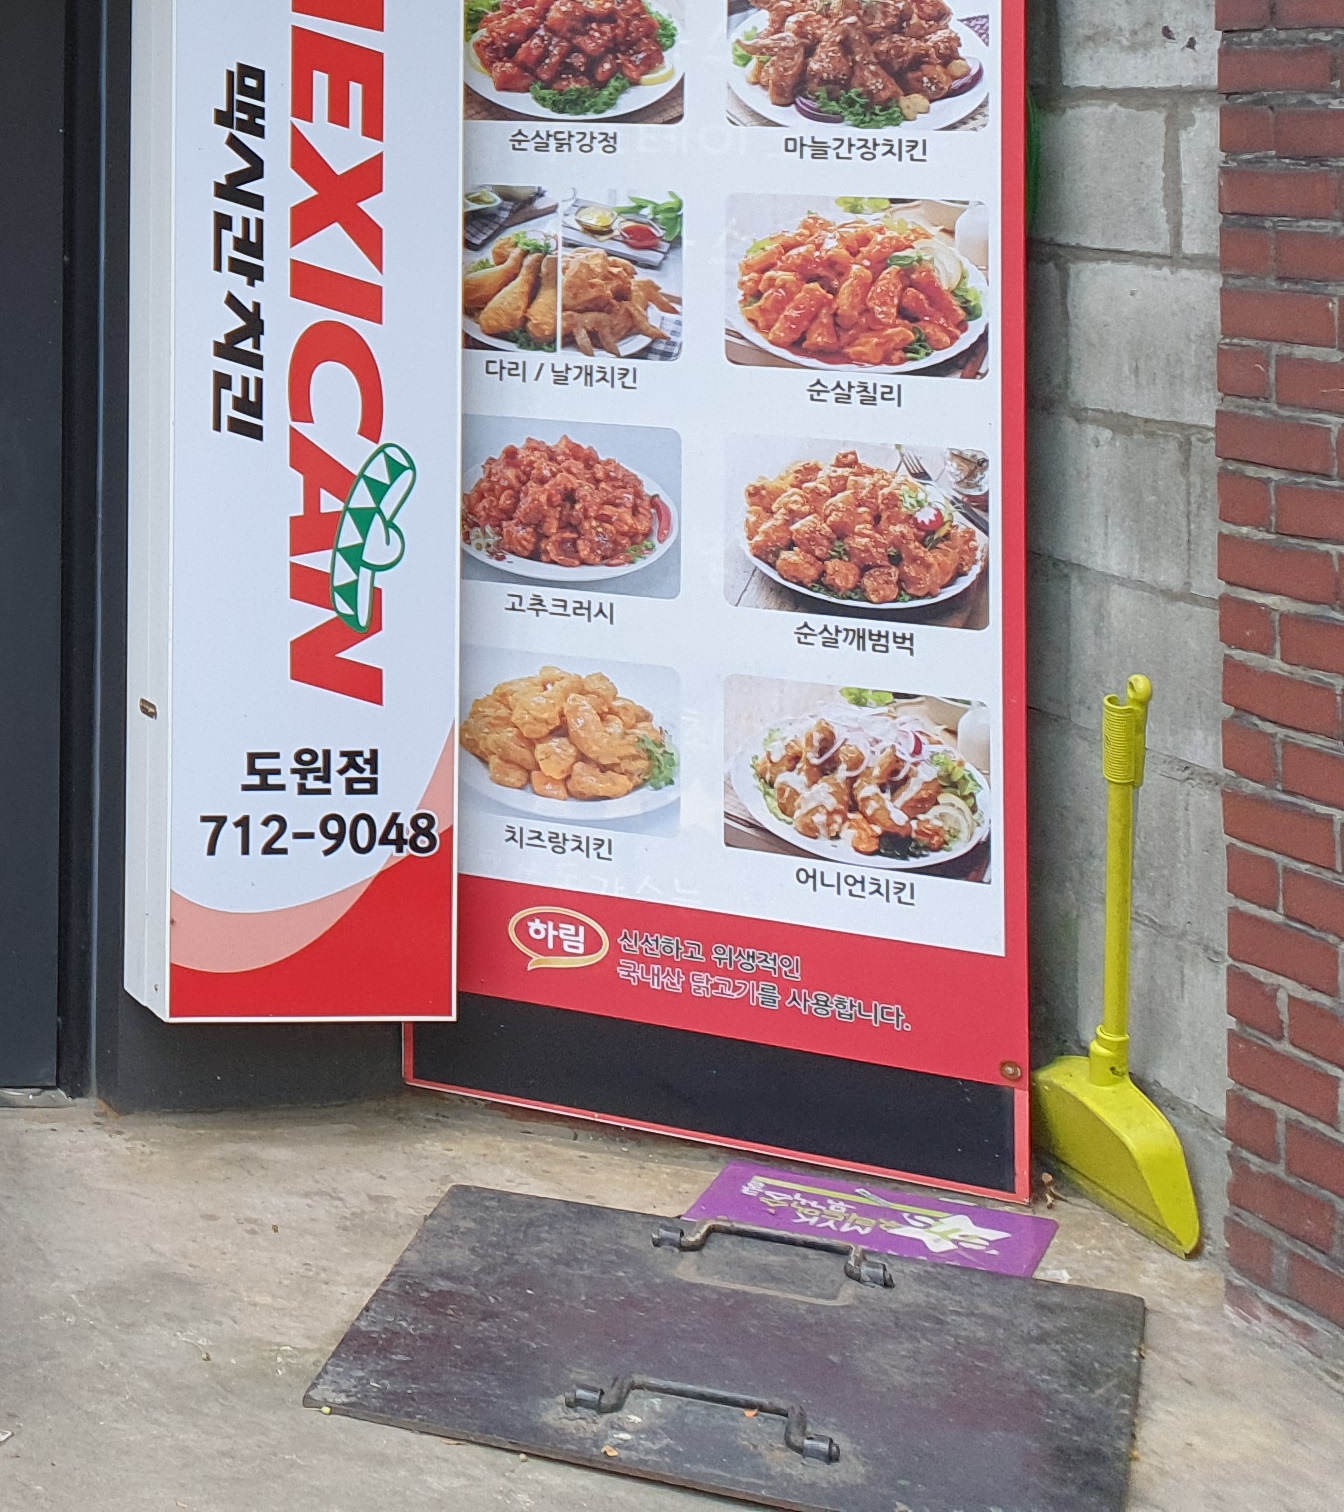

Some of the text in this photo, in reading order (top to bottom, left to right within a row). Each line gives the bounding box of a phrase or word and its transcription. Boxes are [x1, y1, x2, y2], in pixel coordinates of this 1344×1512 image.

[508, 128, 619, 154] 순살닭강정
[783, 136, 928, 164] 마늘간장치킨
[484, 358, 527, 384] 다리
[549, 362, 639, 390] 날개치킨
[805, 378, 903, 408] 순살칠리
[504, 593, 615, 626] 고추크러시
[793, 621, 916, 658] 순살깨범벅
[240, 747, 380, 796] 도원점
[199, 811, 438, 857] 712-9048
[504, 824, 614, 862] 치즈랑치킨
[795, 866, 916, 907] 어니언치킨
[526, 918, 586, 956] 하림
[617, 927, 802, 982] 신선하고 위생적인
[617, 960, 912, 1032] 국내산 닭고기를 사용합니다.
